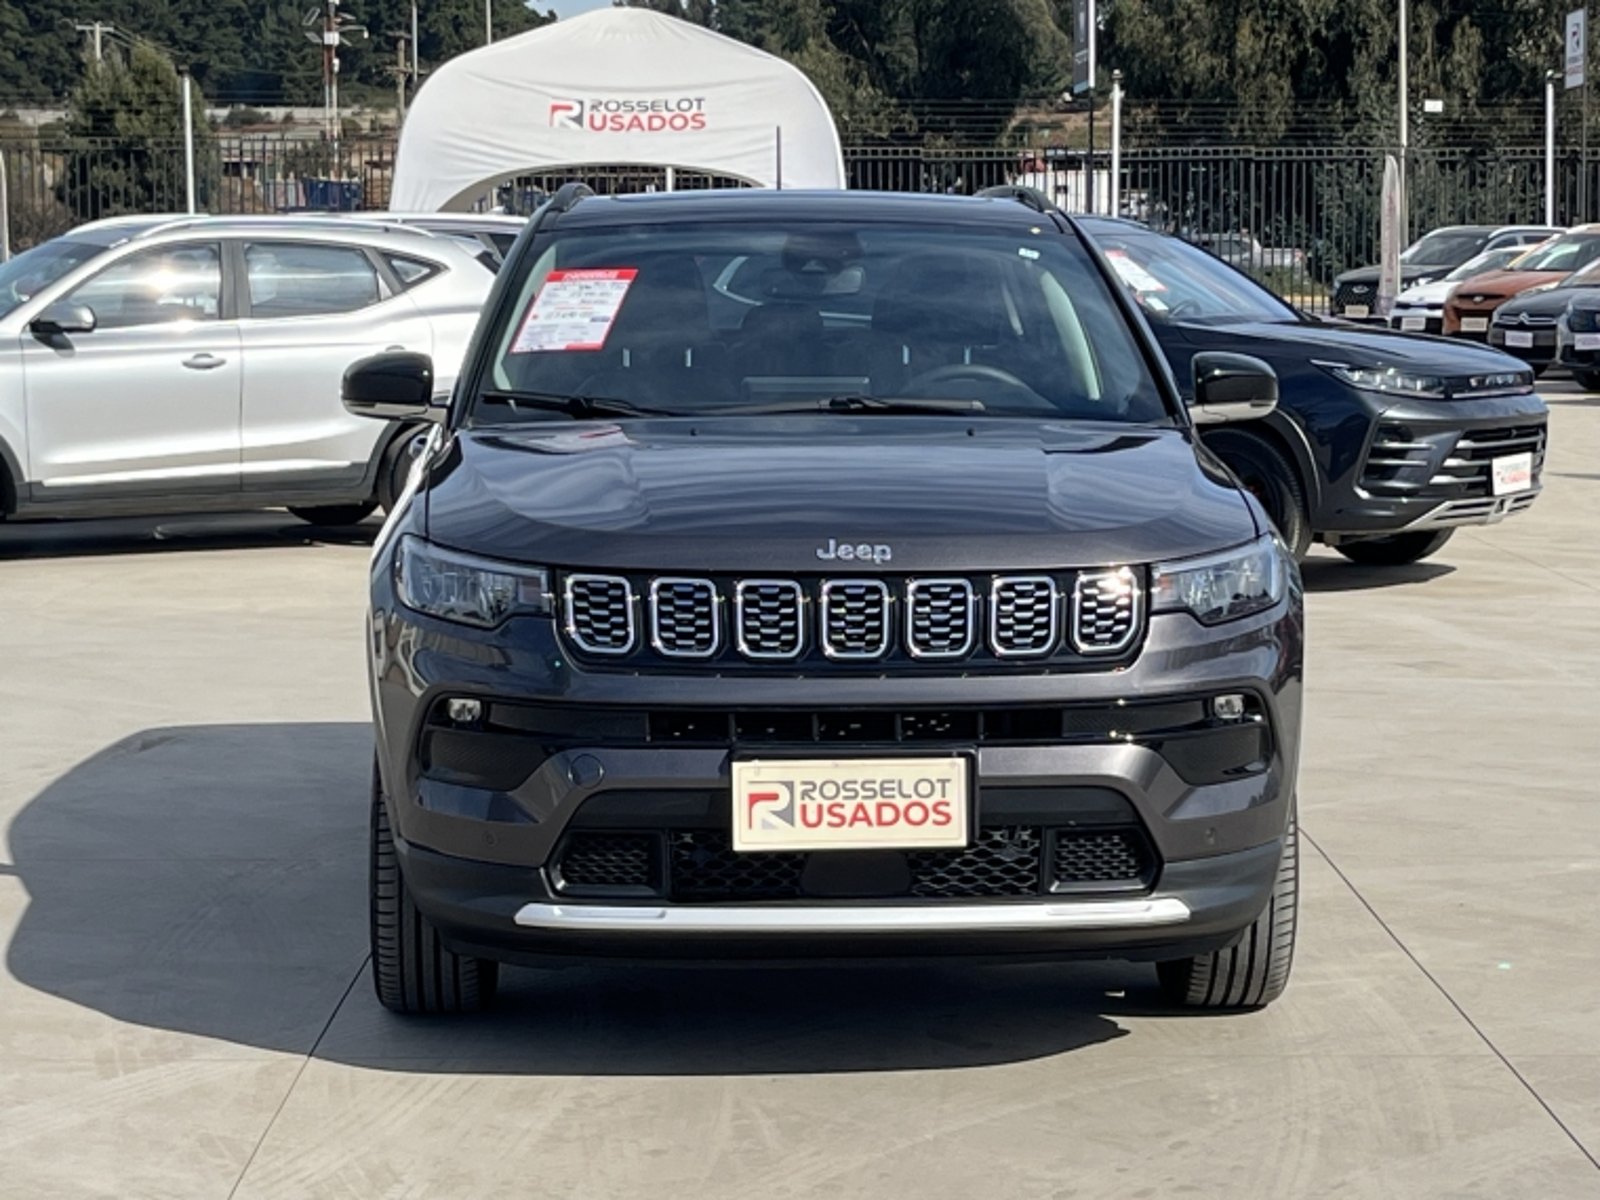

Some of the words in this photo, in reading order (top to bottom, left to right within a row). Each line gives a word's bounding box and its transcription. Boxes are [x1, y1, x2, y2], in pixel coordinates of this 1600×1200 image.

[590, 98, 705, 113] ROSSELOT
[589, 114, 706, 131] USADOS
[816, 538, 891, 564] Jeep
[800, 778, 952, 800] ROSSELOT
[800, 802, 952, 828] USADOS
